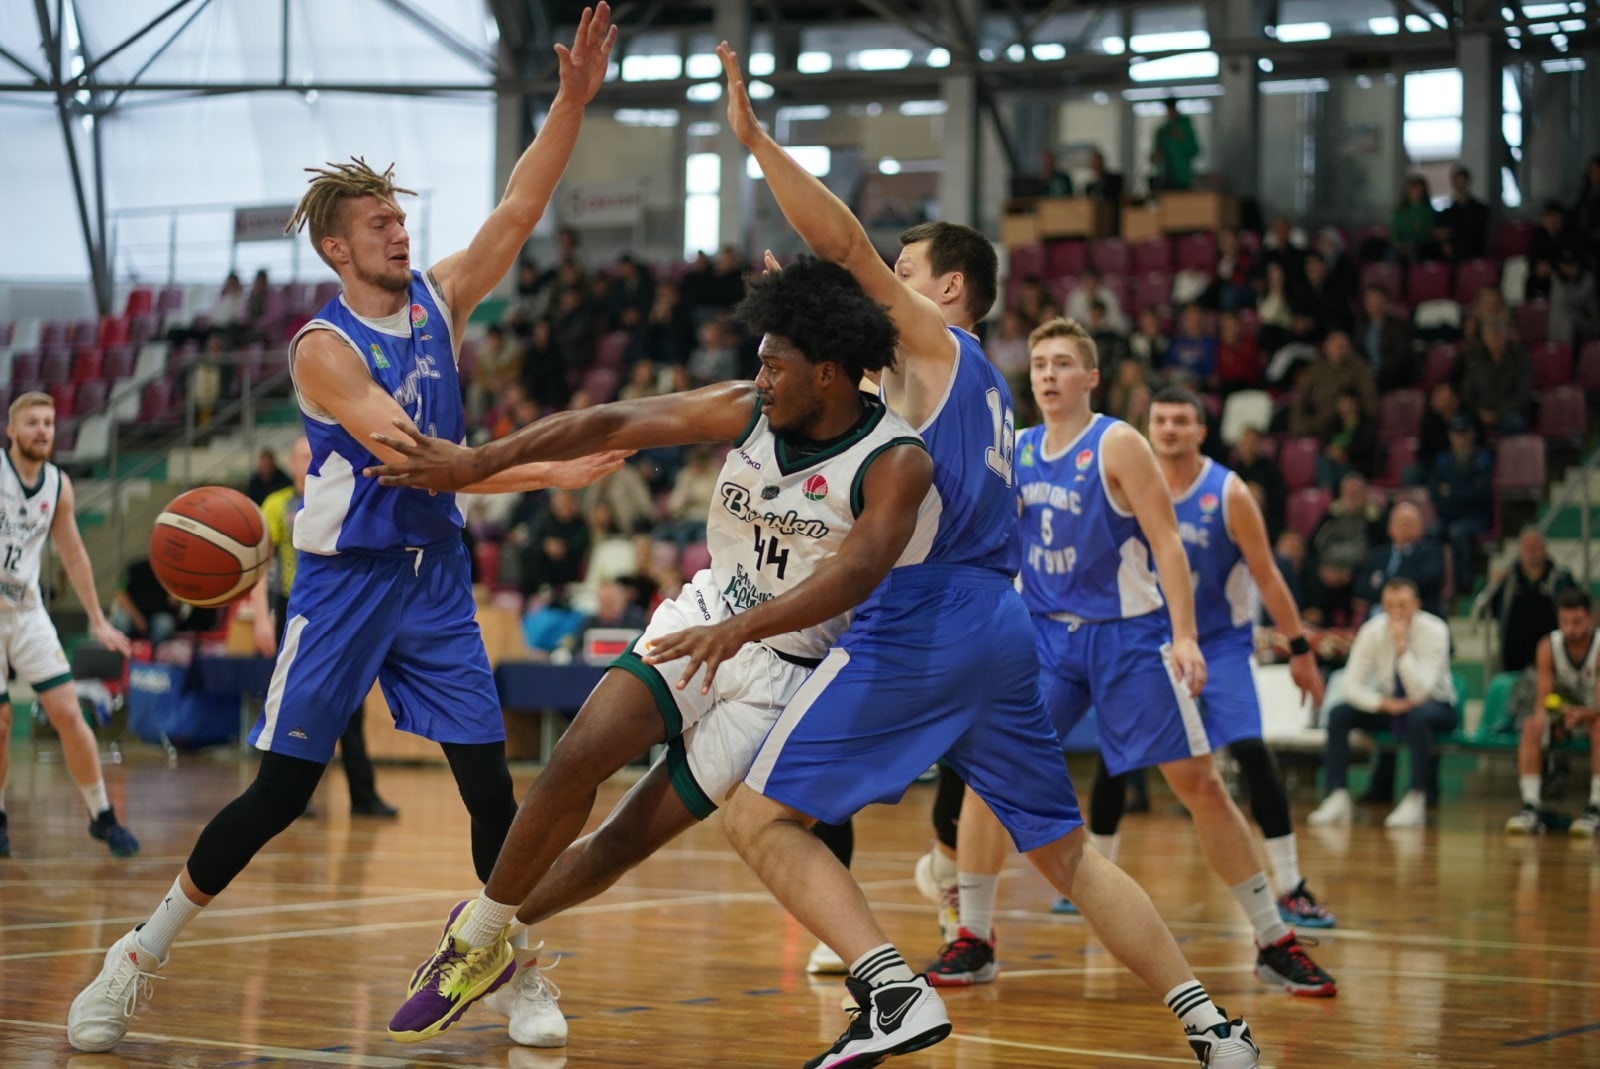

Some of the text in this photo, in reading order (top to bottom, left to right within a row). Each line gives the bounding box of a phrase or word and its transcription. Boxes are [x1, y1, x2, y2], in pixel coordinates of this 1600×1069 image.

[1041, 508, 1054, 547] 5
[4, 543, 23, 573] 12
[754, 524, 790, 580] 44
